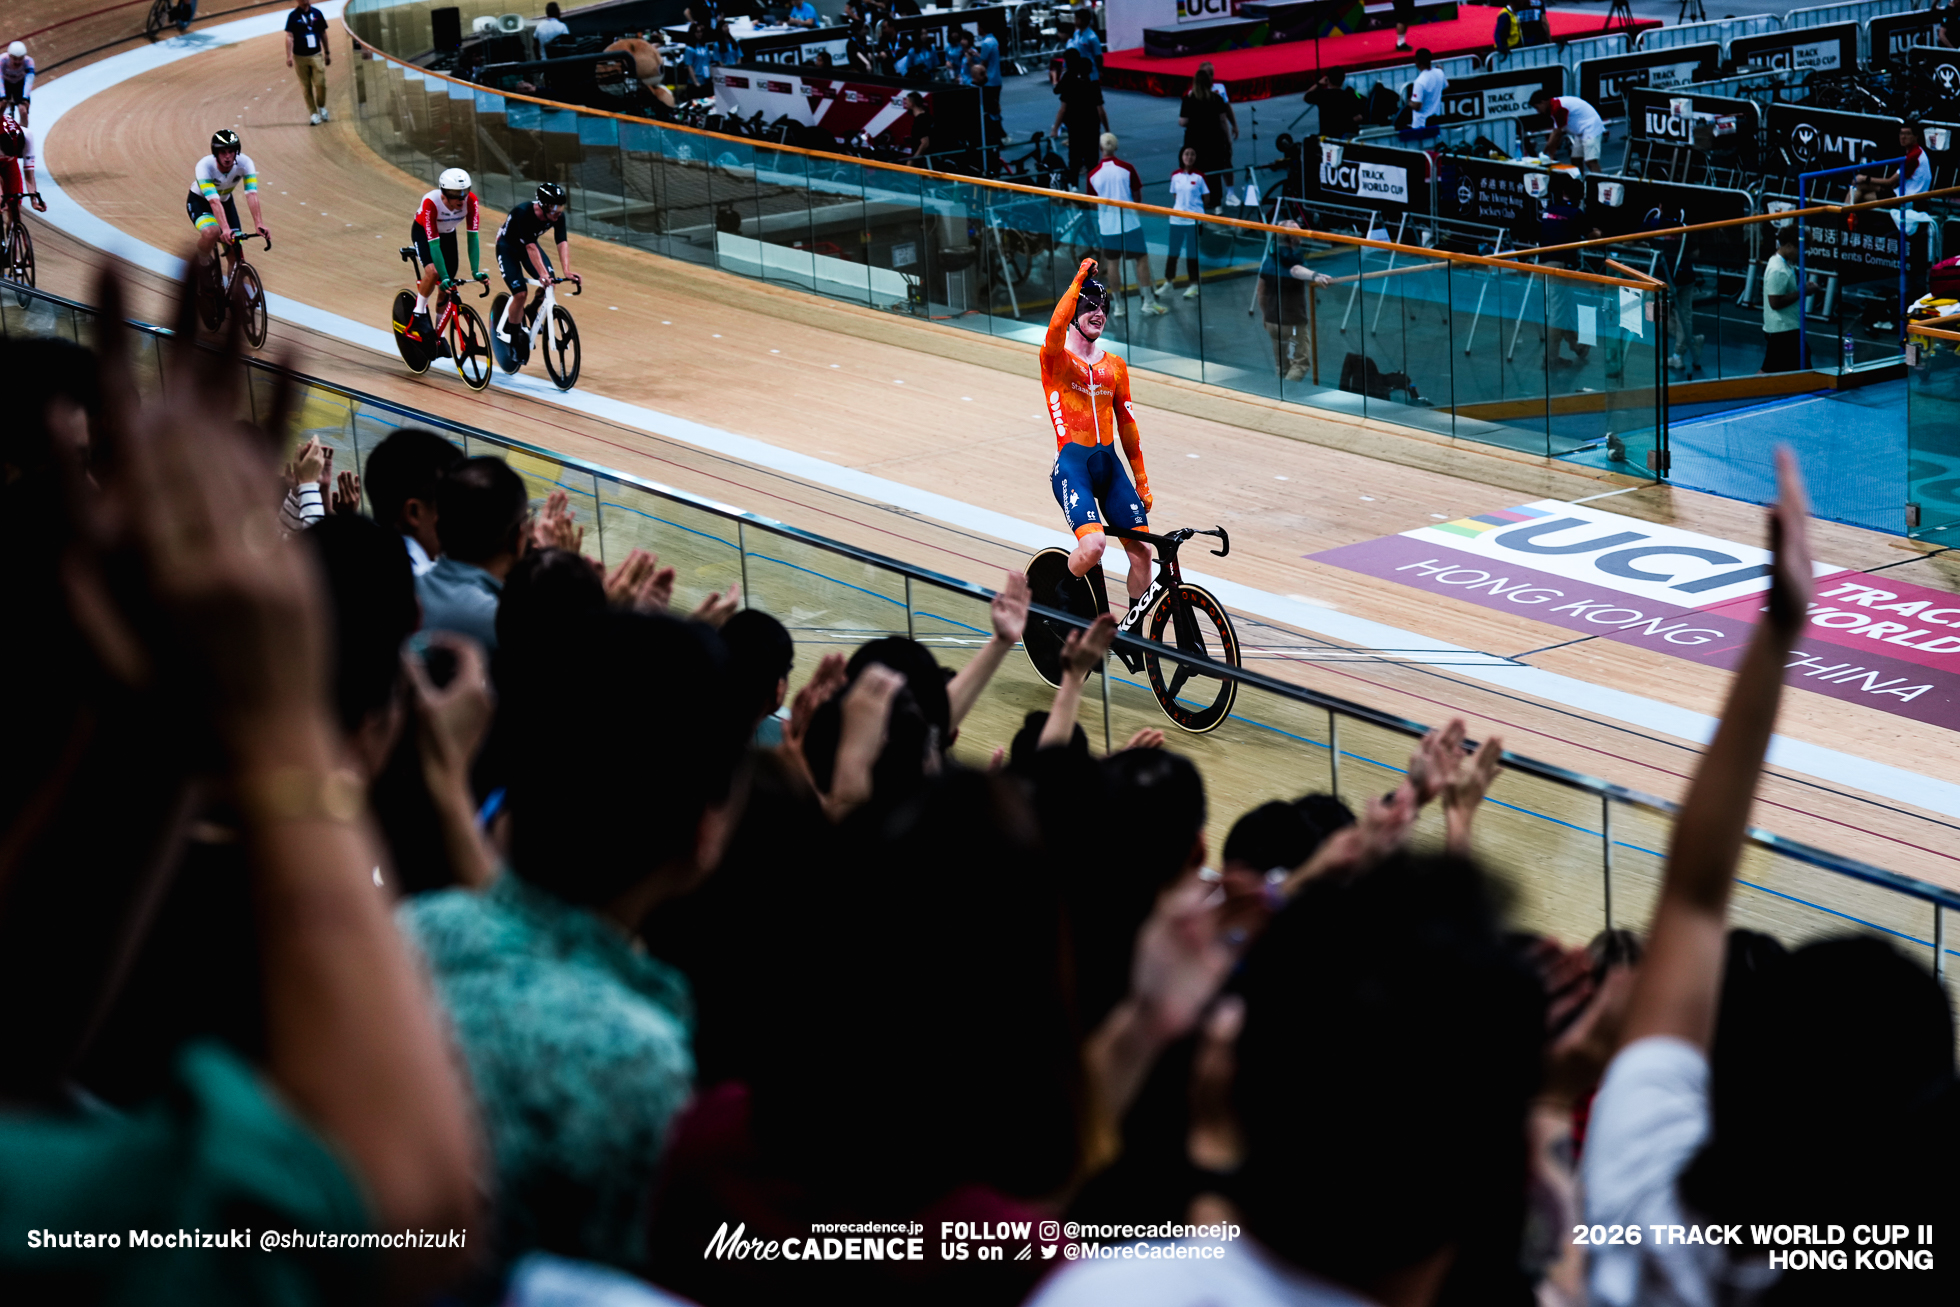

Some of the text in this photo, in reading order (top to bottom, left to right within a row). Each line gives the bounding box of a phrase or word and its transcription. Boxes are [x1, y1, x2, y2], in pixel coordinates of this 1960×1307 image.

[1652, 71, 1677, 81] TRACK
[1487, 92, 1515, 104] TRACK
[1487, 103, 1520, 114] WORLD
[1652, 112, 1687, 138] UCI
[1327, 163, 1357, 189] UCI
[1361, 169, 1386, 181] TRACK
[1362, 181, 1404, 195] WORLD CUP
[425, 209, 433, 240] PORTUGAL
[1117, 580, 1163, 631] KOGA
[1396, 558, 1565, 604] HONG
[1549, 599, 1725, 645] KONG
